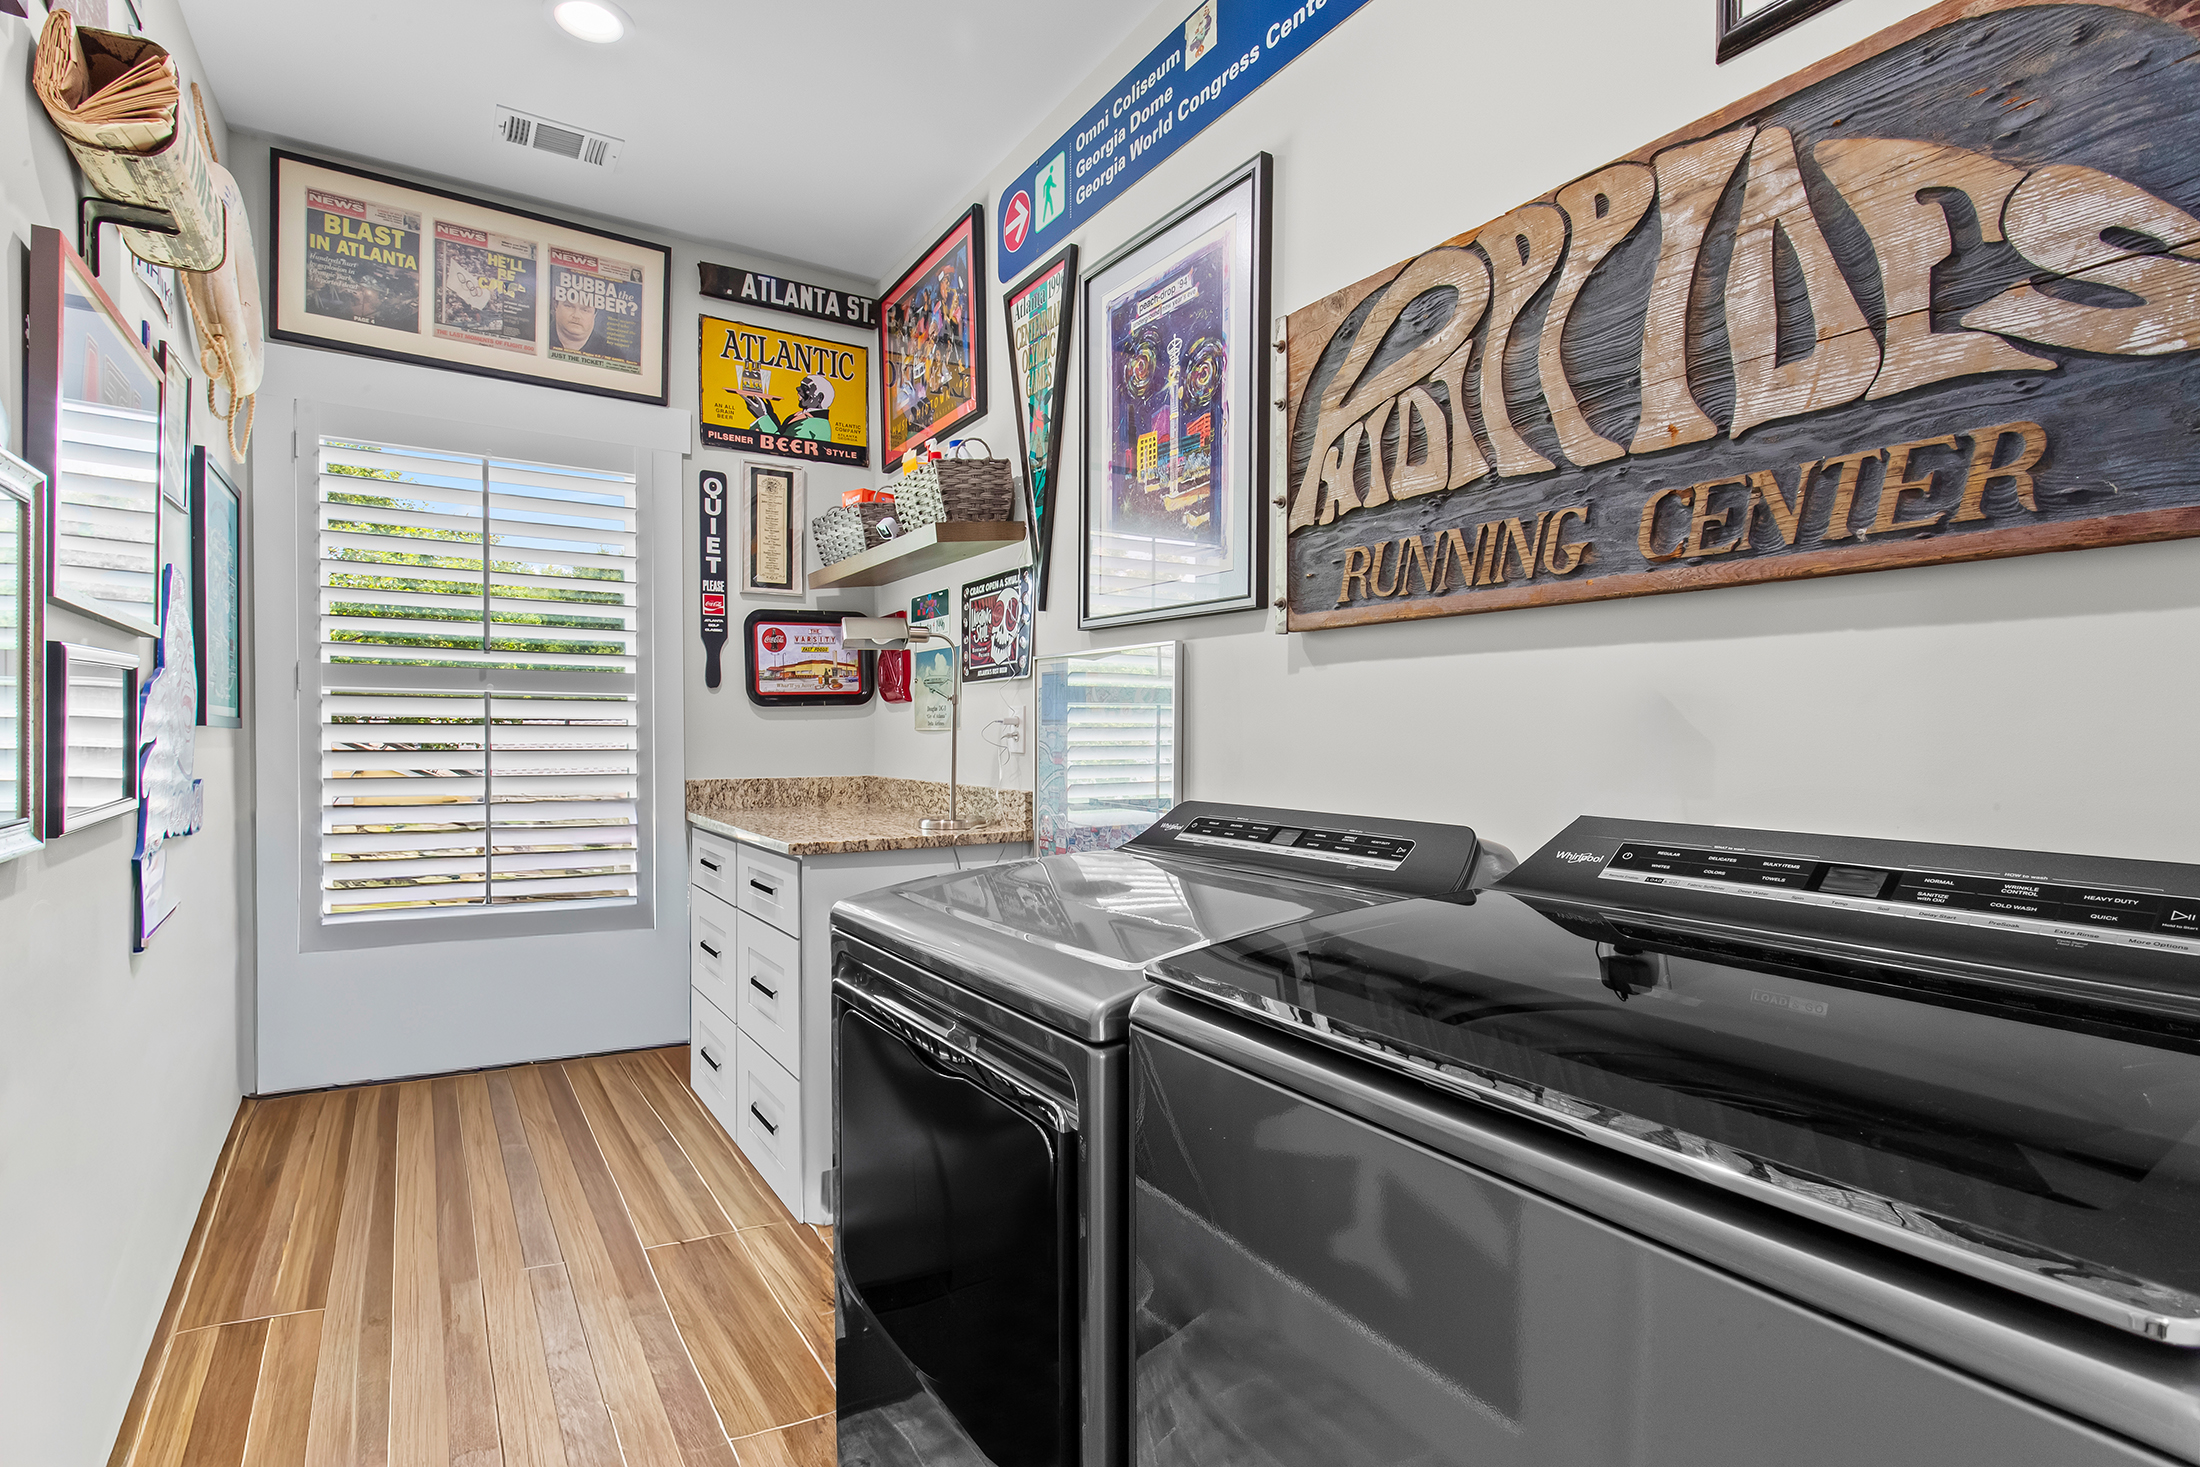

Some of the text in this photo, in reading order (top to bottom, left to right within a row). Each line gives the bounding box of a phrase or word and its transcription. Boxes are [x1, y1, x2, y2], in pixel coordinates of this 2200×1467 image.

[1075, 49, 1180, 152] Omni Coliseum
[1075, 44, 1259, 206] Georgia World Congress
[1075, 85, 1173, 179] Georgia Dome
[308, 193, 365, 213] NEWS
[324, 213, 405, 249] BLAST
[437, 225, 487, 242] NEWS
[309, 233, 418, 271] IN ATLANTA
[487, 252, 527, 274] HE'LL
[552, 251, 597, 268] NEWS
[497, 268, 517, 282] BE
[560, 271, 635, 302] BUBBA the
[555, 285, 639, 317] BOMBER?
[740, 272, 876, 325] ATLANTA ST.
[1014, 288, 1046, 323] Atlanta
[1139, 285, 1176, 314] peach-drop
[353, 315, 370, 323] PAGE
[465, 334, 494, 344] MOMENTS
[504, 341, 523, 350] FLIGHT
[720, 329, 855, 382] ATLANTIC
[1022, 331, 1056, 374] OLYMPIC
[1026, 361, 1052, 399] GAMES
[715, 408, 735, 416] GRAIN
[724, 403, 736, 411] ALL
[835, 421, 862, 430] ATLANTIC
[835, 426, 862, 435] COMPANY
[708, 430, 858, 459] PILSENER BEER STYLE
[1337, 420, 2051, 603] RUNNING CENTER
[702, 477, 723, 574] QUIET
[702, 579, 725, 592] PLEASE
[970, 585, 985, 596] CRACK
[985, 581, 999, 592] OPEN
[999, 578, 1004, 587] A
[763, 634, 785, 644] Coca-Cola
[794, 635, 836, 643] VARSITY
[1160, 822, 1185, 831] Whirlpool
[1556, 850, 1605, 864] Whirlpool
[1708, 855, 1738, 863] DELICATES
[1762, 875, 1786, 883] TOWELS
[1924, 878, 1955, 886] NORMAL
[1917, 891, 1950, 900] SANITIZE
[2000, 888, 2039, 898] CONTROL
[2004, 884, 2040, 893] WRINKLE
[1990, 901, 2038, 912] COLD WASH
[2083, 894, 2140, 906] HEAVY DUTY
[1918, 911, 1939, 919] Delay
[2090, 913, 2119, 922] QUICK
[1988, 920, 2020, 929] PreSoak
[2054, 928, 2100, 939] Extra Rinse
[2153, 940, 2189, 951] Options
[1754, 991, 1788, 1006] LOAD
[1805, 1002, 1824, 1014] GO
